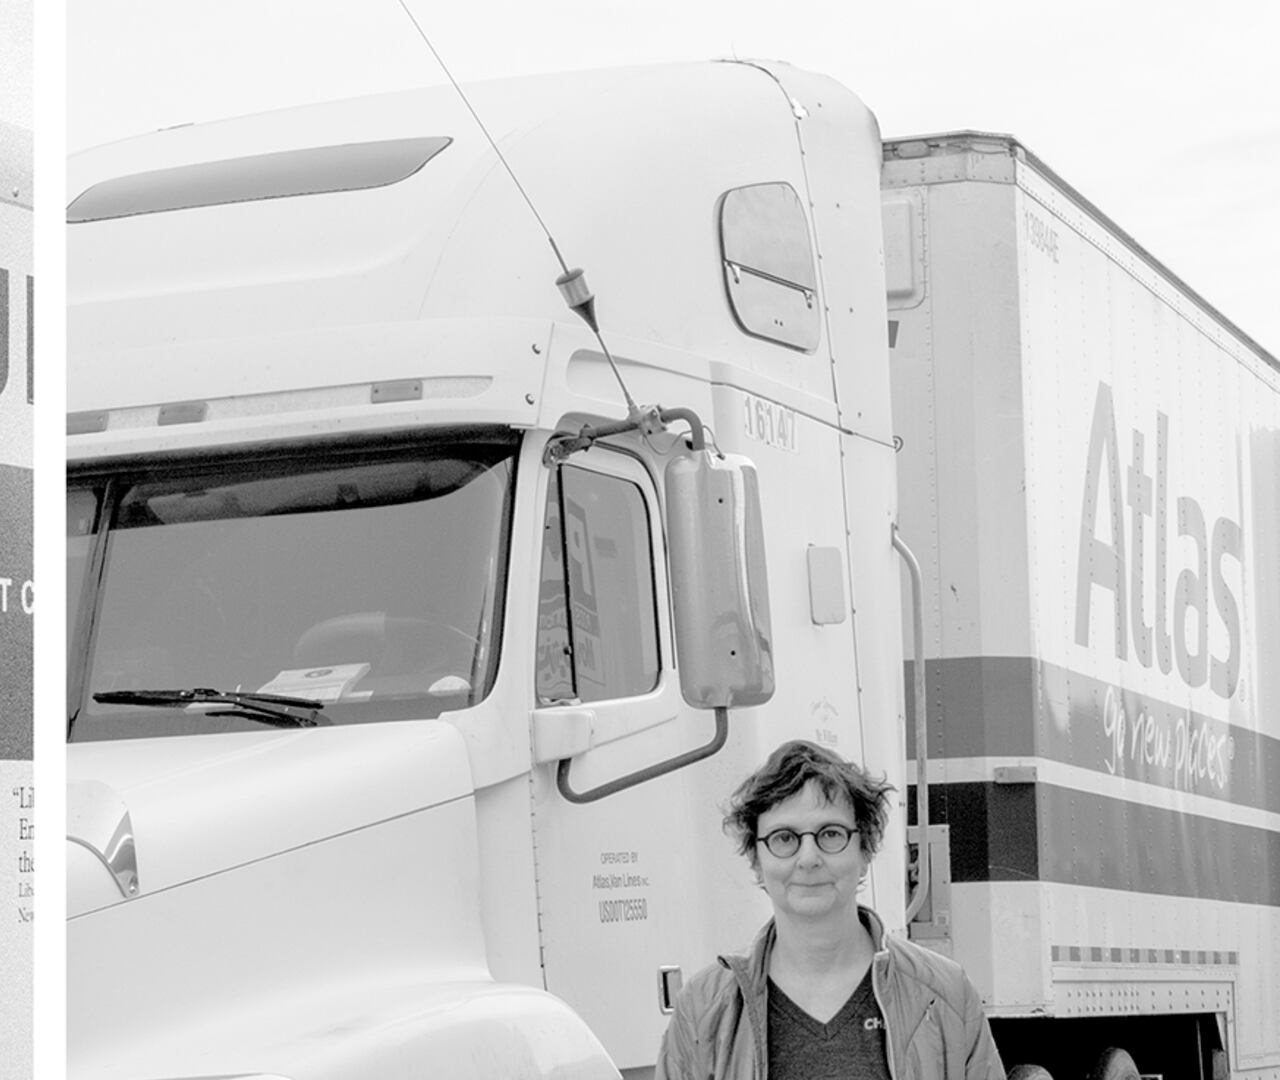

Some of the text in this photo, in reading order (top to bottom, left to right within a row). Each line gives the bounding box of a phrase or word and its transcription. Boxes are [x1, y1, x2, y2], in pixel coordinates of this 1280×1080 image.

[744, 396, 796, 450] 16147
[1074, 379, 1242, 700] Atlas
[1104, 685, 1126, 775] go
[1130, 712, 1171, 769] new
